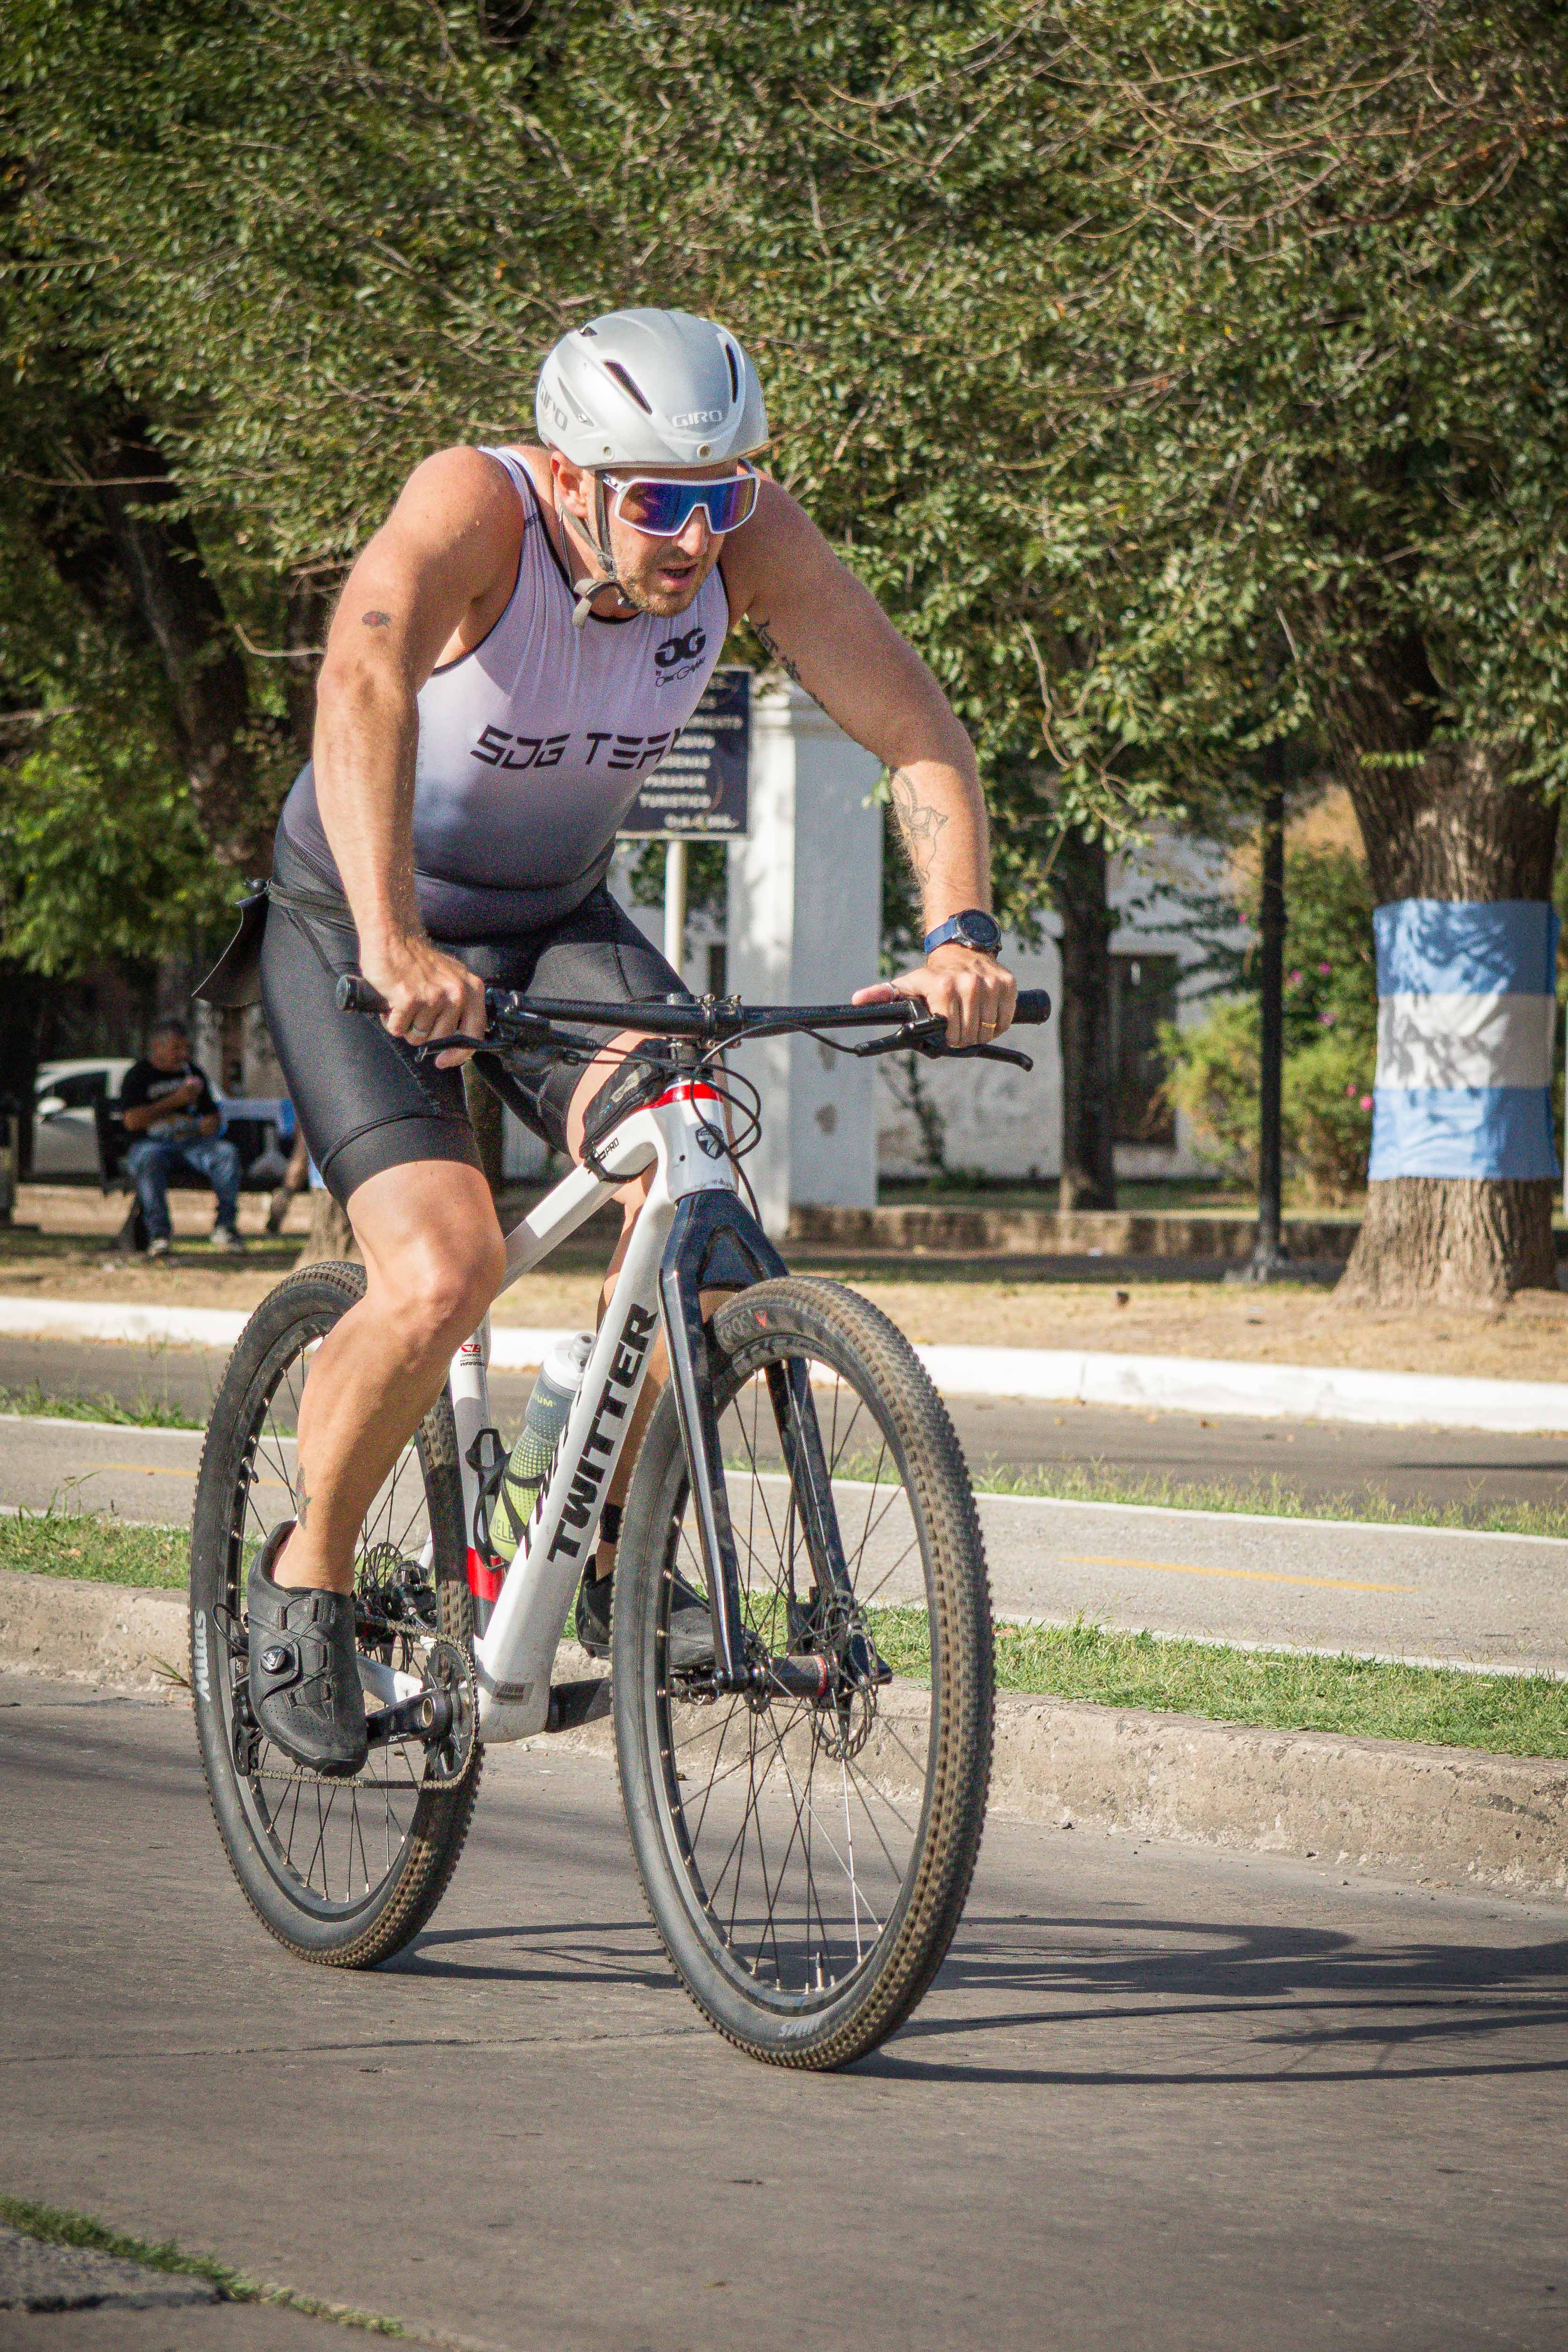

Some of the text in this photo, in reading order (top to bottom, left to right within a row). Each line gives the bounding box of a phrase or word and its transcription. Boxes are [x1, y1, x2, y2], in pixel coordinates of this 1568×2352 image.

[672, 411, 722, 428] GIRO
[586, 727, 681, 770] TEA
[605, 1138, 619, 1155] PRO
[546, 1303, 658, 1562] TWITTER
